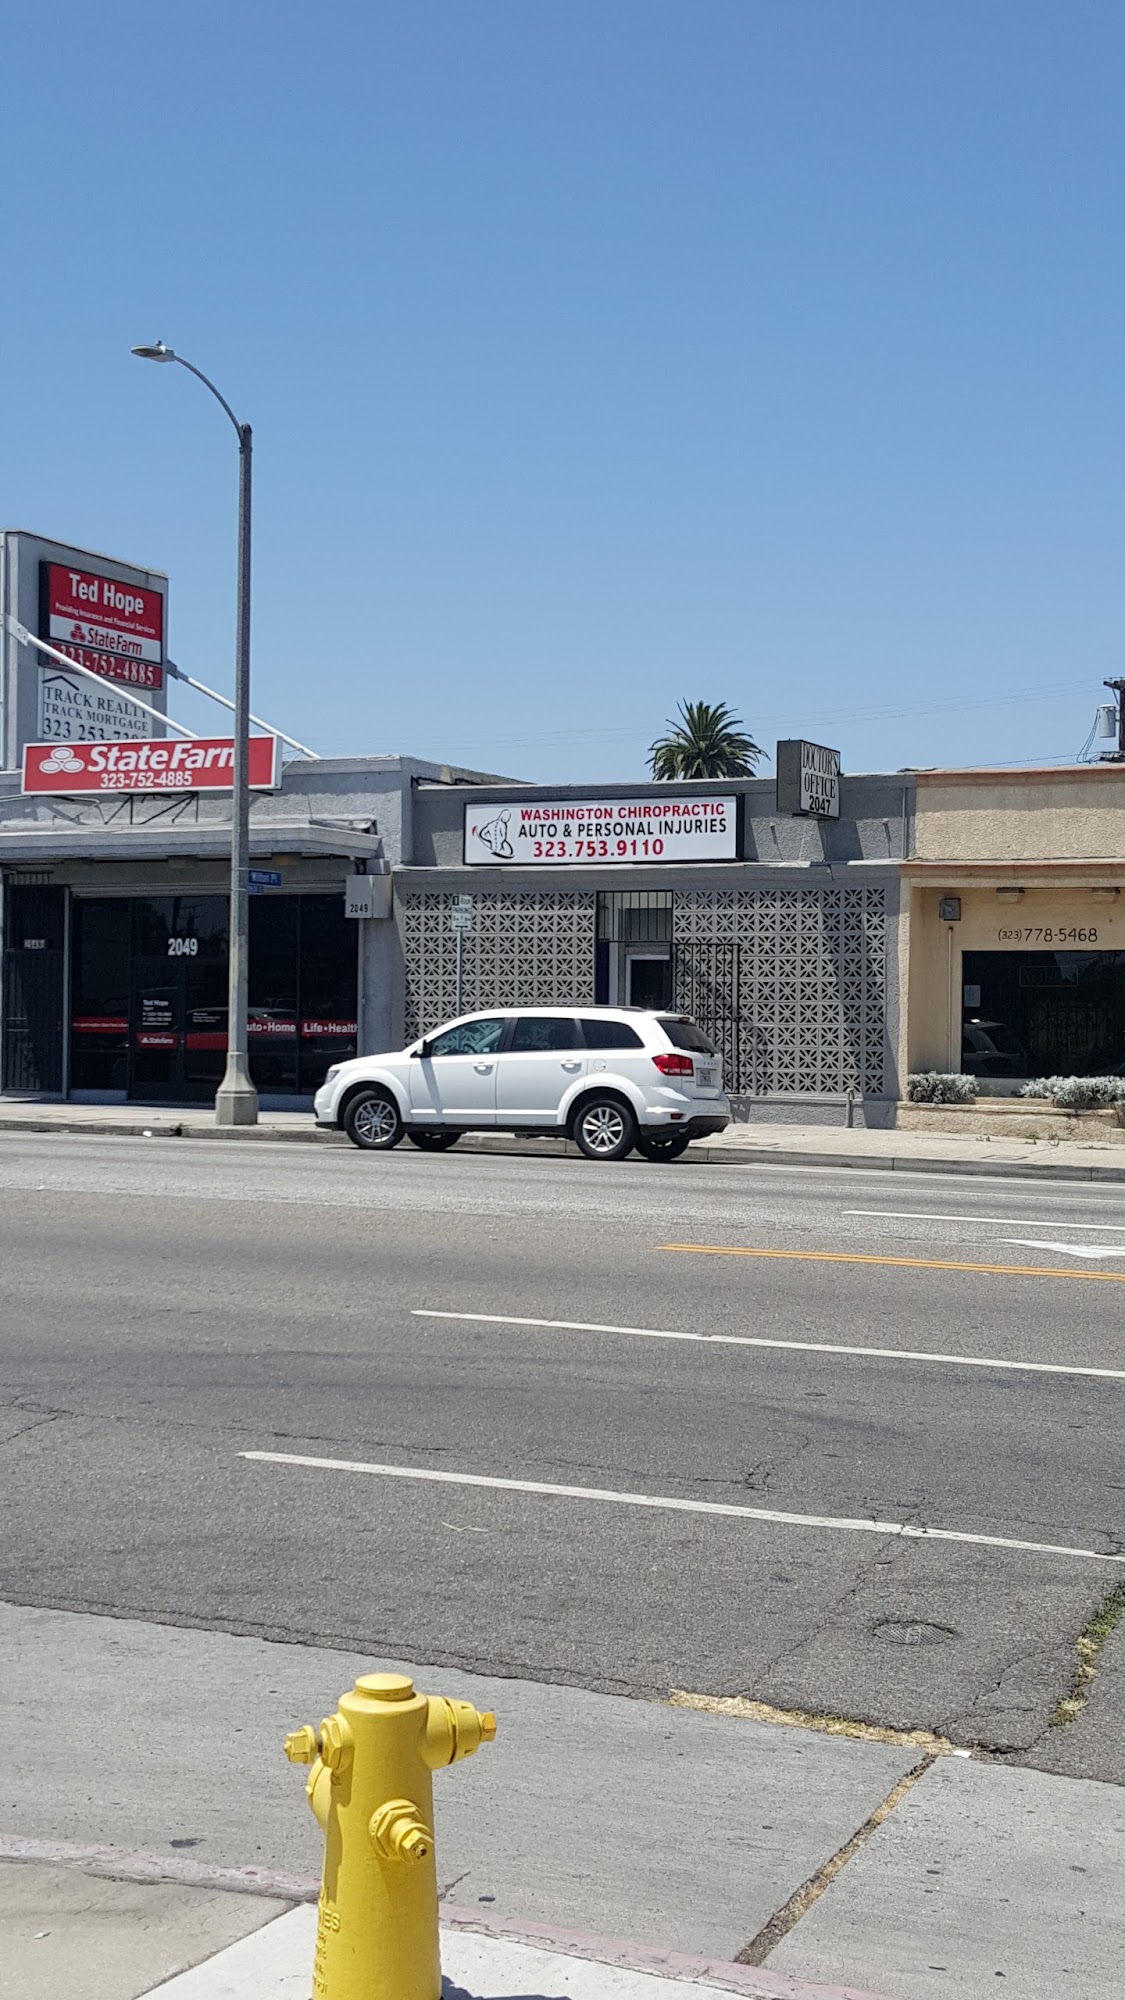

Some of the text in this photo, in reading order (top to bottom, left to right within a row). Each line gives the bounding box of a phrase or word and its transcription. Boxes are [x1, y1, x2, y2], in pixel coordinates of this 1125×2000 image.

[69, 573, 144, 616] Ted Hope
[44, 686, 93, 708] TRACK
[44, 702, 148, 732] TRACK MORTGAGE
[43, 718, 71, 738] 323
[101, 771, 192, 788] 323-752-4885
[804, 772, 836, 798] OFFICE
[521, 803, 725, 821] WASHINGTON CHIROPRACTIC
[809, 795, 831, 814] 2047
[518, 818, 727, 838] AUTO & PERSONAL INJURIES
[533, 838, 664, 858] 323.753.9110
[350, 903, 369, 913] 2049
[167, 938, 198, 956] 2049
